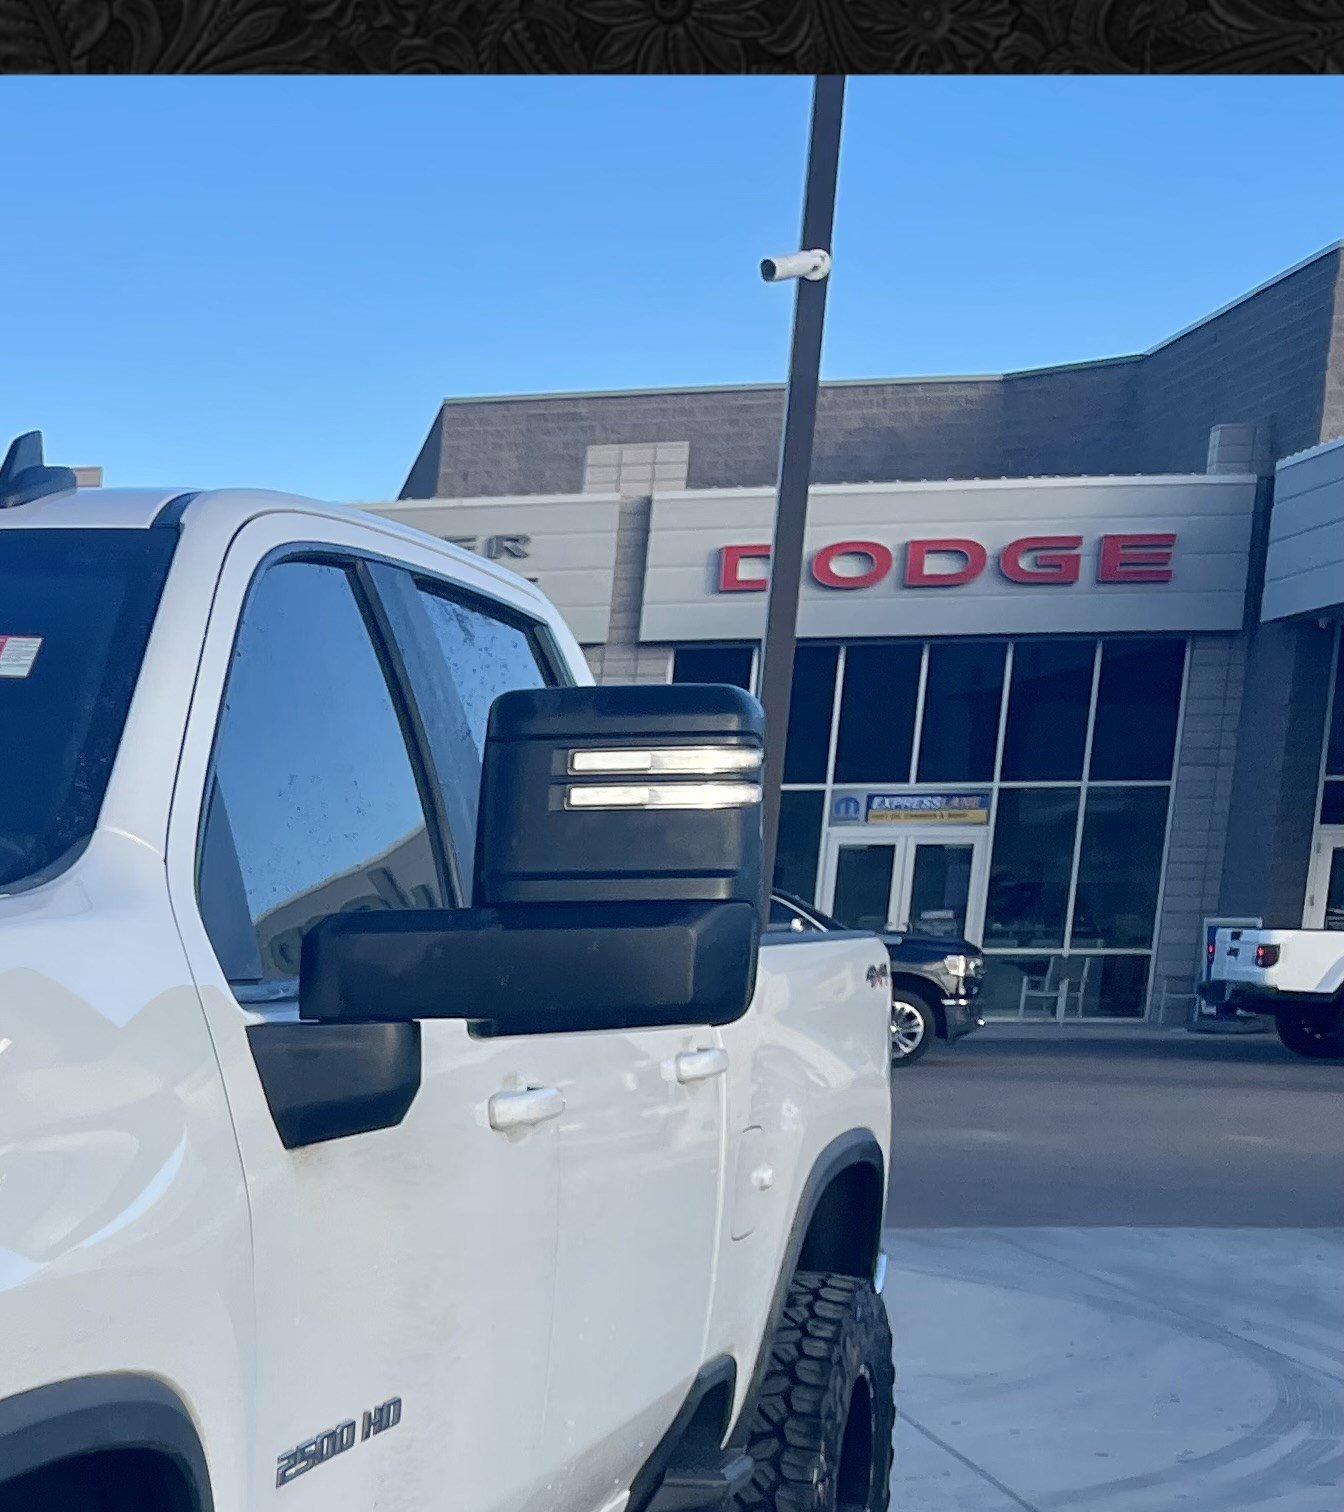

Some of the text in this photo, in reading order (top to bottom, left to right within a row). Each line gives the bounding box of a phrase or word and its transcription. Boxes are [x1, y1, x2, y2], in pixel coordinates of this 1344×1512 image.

[718, 533, 1177, 592] DODGE
[275, 1395, 402, 1489] 2500 HD
